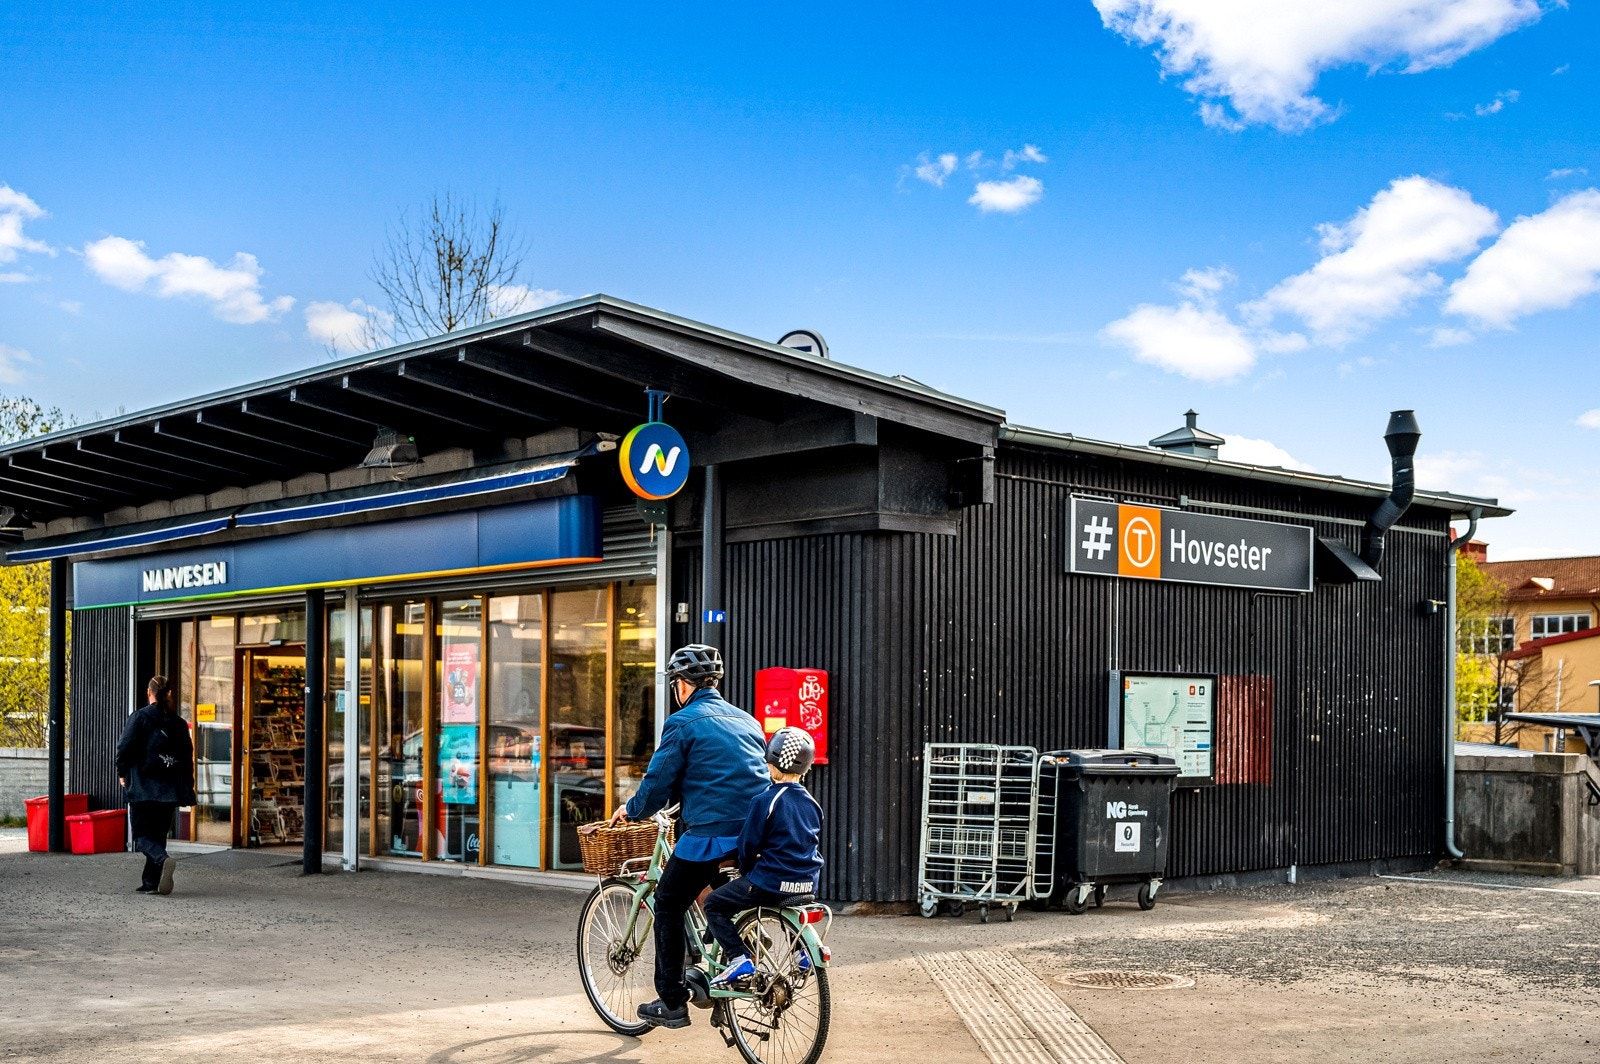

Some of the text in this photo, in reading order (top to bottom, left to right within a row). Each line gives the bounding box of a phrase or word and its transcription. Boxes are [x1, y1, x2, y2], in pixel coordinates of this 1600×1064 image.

[640, 443, 681, 477] N
[1131, 528, 1149, 561] T
[1170, 528, 1272, 571] Hovseter
[142, 561, 227, 592] NARVESEN
[1106, 801, 1127, 819] NG
[779, 881, 814, 893] MAGNUS
